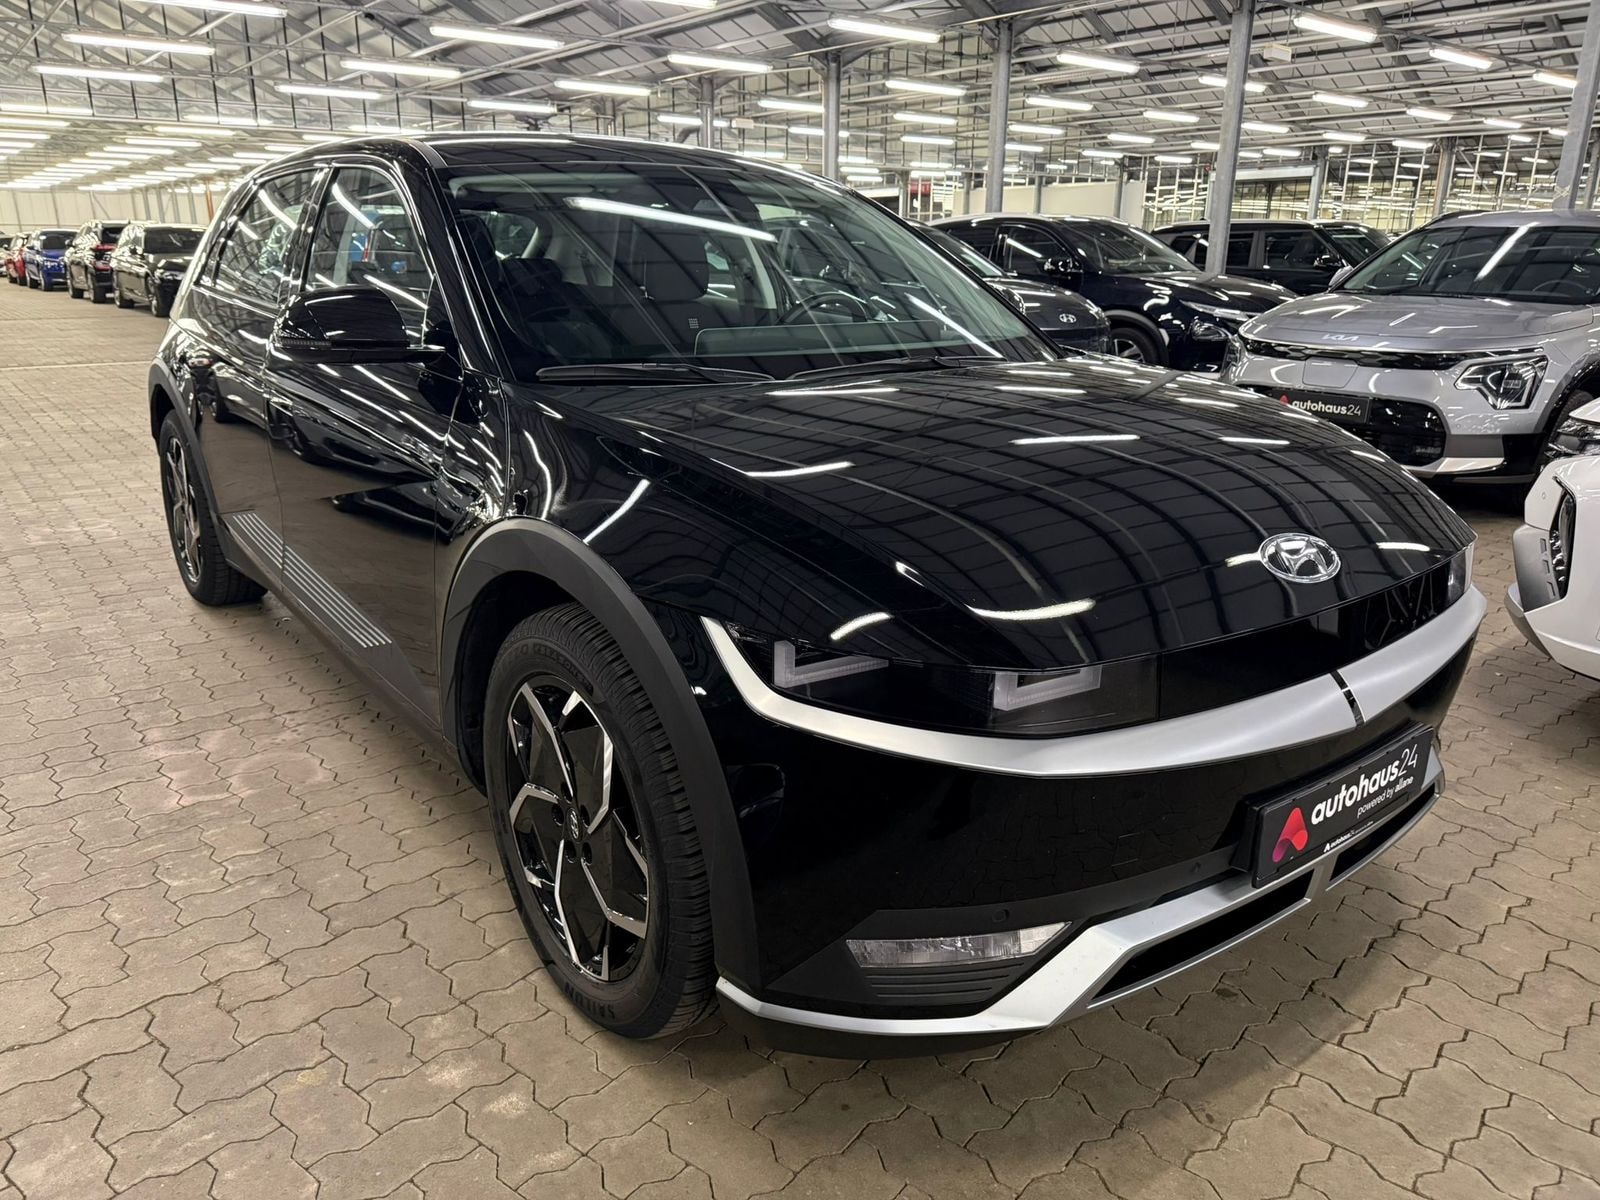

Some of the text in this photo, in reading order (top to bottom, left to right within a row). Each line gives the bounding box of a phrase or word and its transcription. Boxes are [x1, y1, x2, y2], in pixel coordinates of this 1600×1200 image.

[1292, 400, 1361, 416] autohaus24
[1311, 744, 1418, 825] autohaus24
[1357, 790, 1386, 818] powered
[1386, 786, 1394, 799] by
